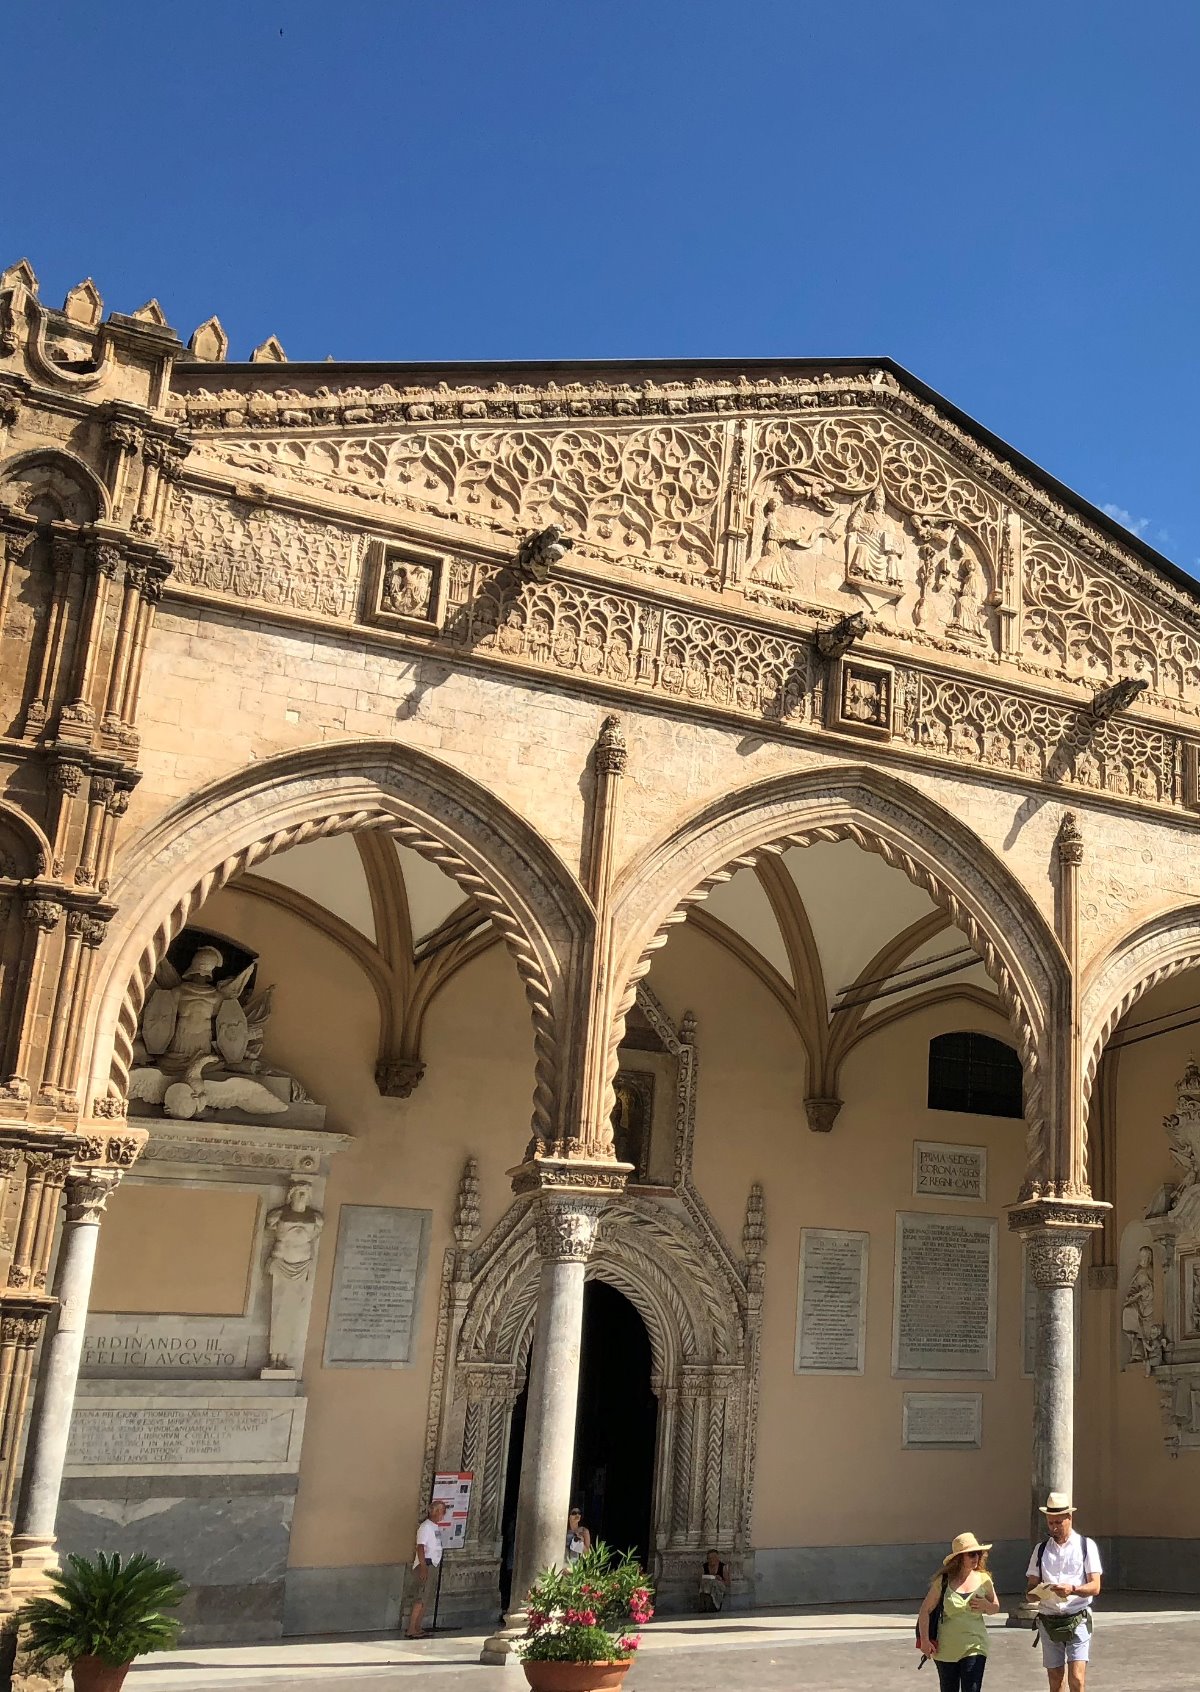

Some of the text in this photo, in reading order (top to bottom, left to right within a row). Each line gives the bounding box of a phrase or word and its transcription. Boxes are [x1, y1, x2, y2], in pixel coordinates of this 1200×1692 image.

[83, 1335, 196, 1351] ERDINANDO
[85, 1350, 235, 1367] FELICI AVGVSTO
